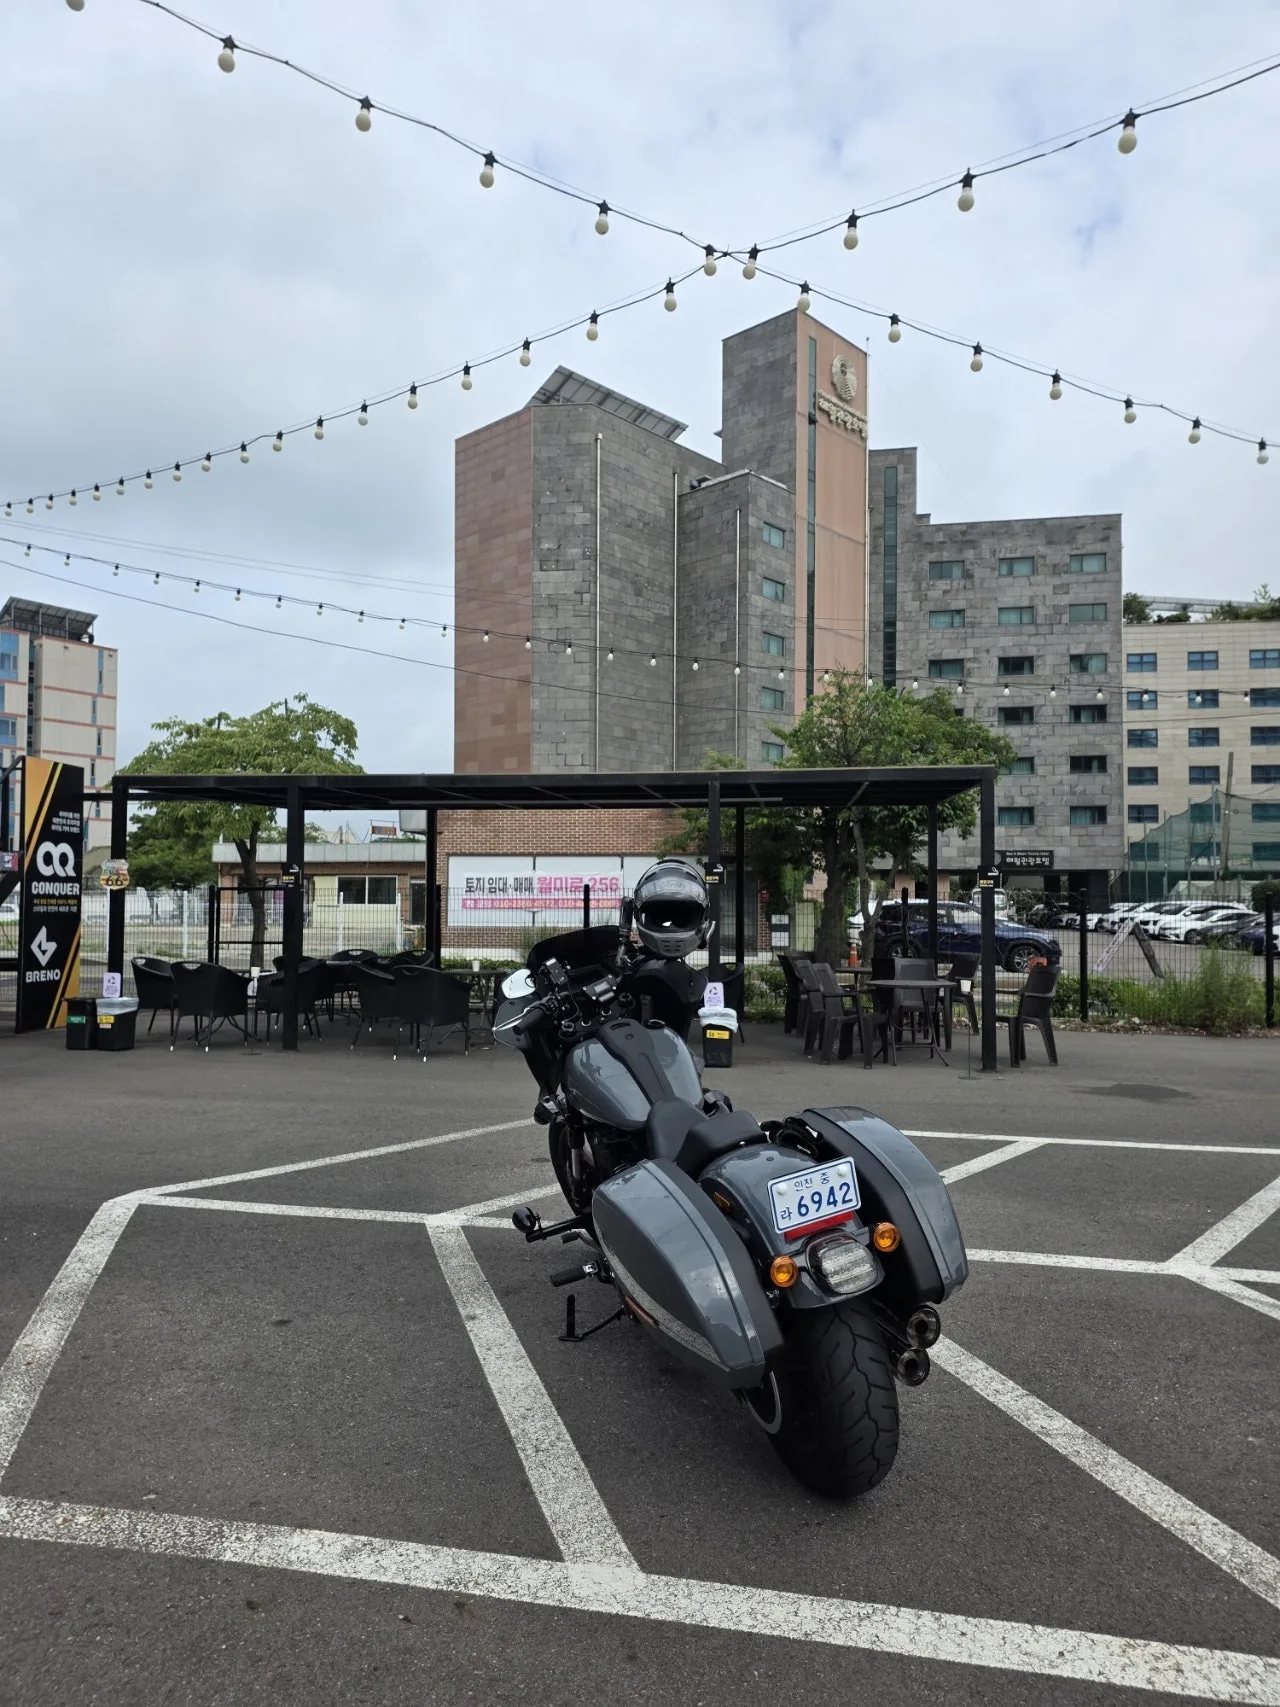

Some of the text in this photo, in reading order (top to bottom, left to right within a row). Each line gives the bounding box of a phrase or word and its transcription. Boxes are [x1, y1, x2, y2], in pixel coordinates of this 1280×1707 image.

[106, 875, 123, 886] 66
[465, 877, 485, 893] 토지
[537, 876, 584, 894] 월미로
[588, 877, 619, 893] 256
[31, 881, 80, 896] CONQUER
[26, 968, 61, 983] BRENO
[820, 1171, 830, 1185] 중
[779, 1182, 853, 1221] 라 6942
